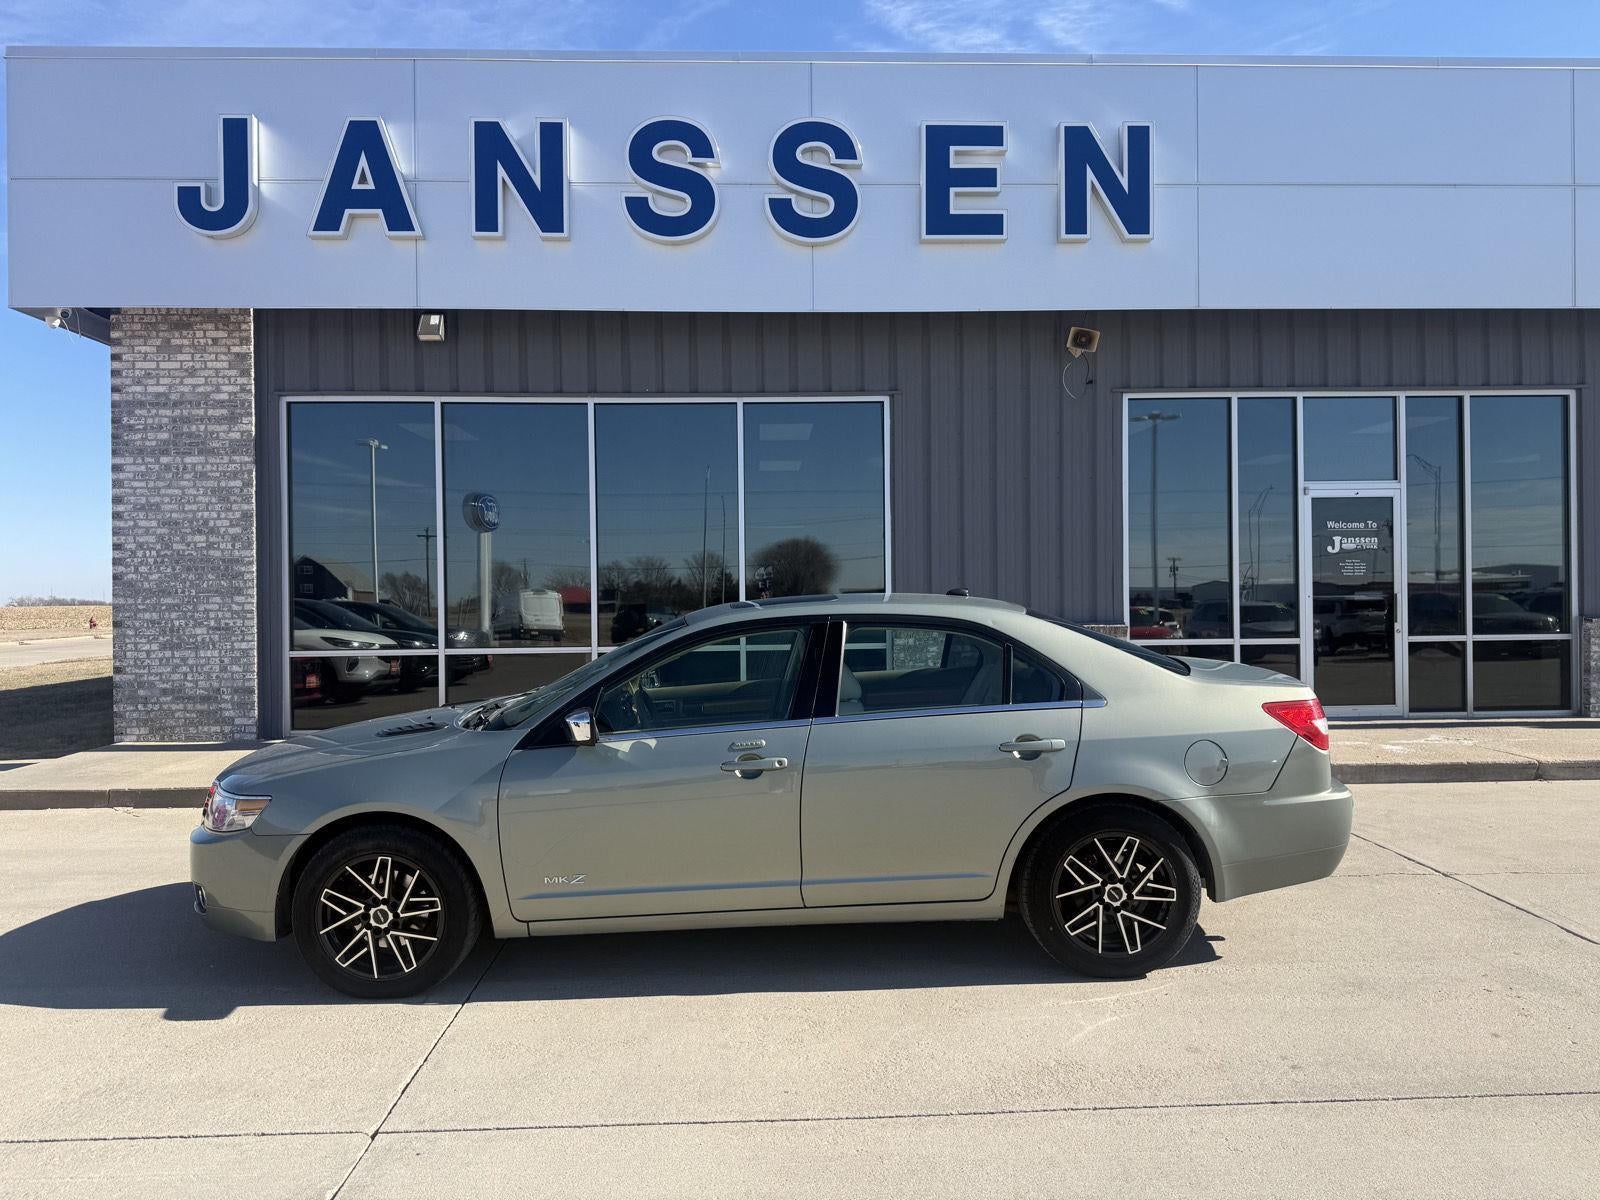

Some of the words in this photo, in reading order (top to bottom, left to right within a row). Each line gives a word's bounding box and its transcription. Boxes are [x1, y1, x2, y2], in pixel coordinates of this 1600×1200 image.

[174, 114, 1154, 243] JANSSEN
[1326, 520, 1365, 529] Welcome
[1366, 520, 1378, 529] To
[1326, 535, 1378, 554] Janssen
[543, 874, 587, 884] MKZ
